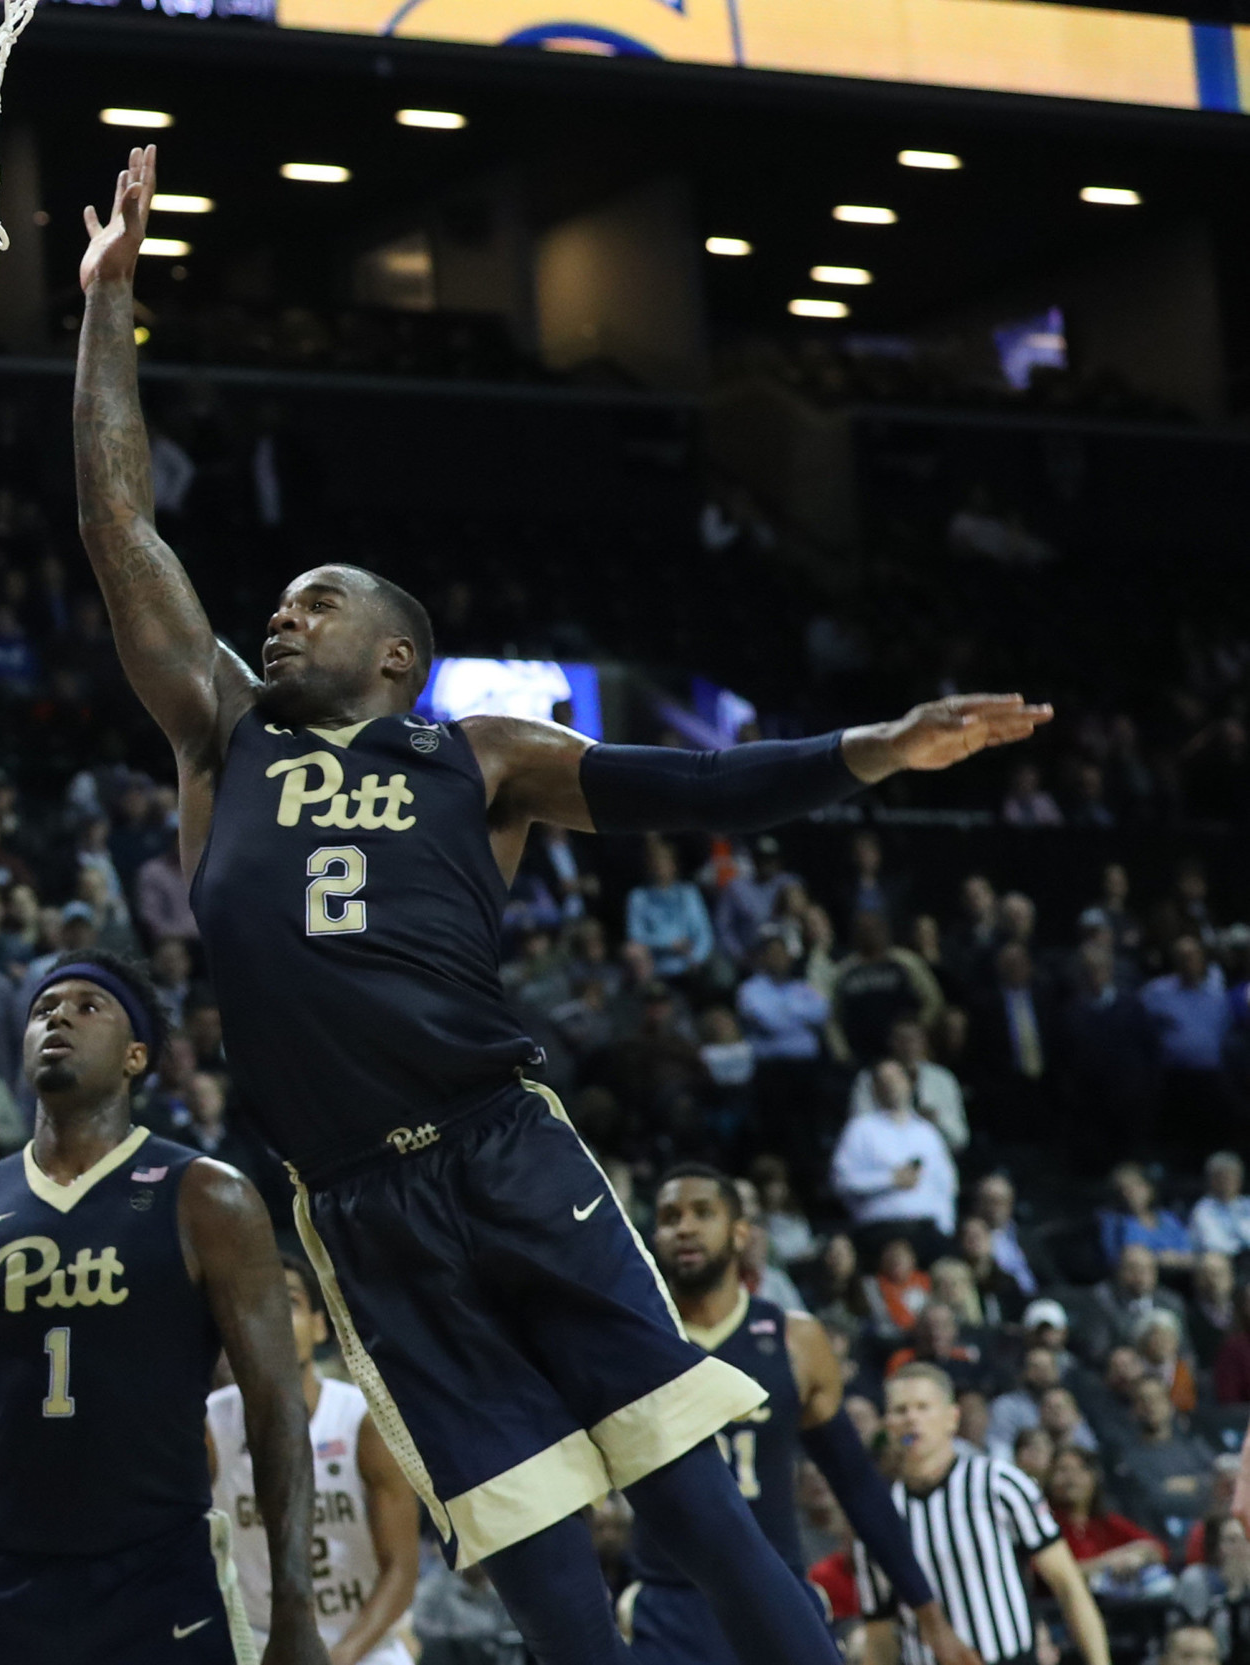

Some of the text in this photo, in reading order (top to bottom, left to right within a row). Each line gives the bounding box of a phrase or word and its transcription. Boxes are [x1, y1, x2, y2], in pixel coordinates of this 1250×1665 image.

[265, 750, 417, 832] Pitt
[306, 844, 367, 937] 2
[386, 1122, 441, 1154] Pitt
[42, 1326, 76, 1418] 1
